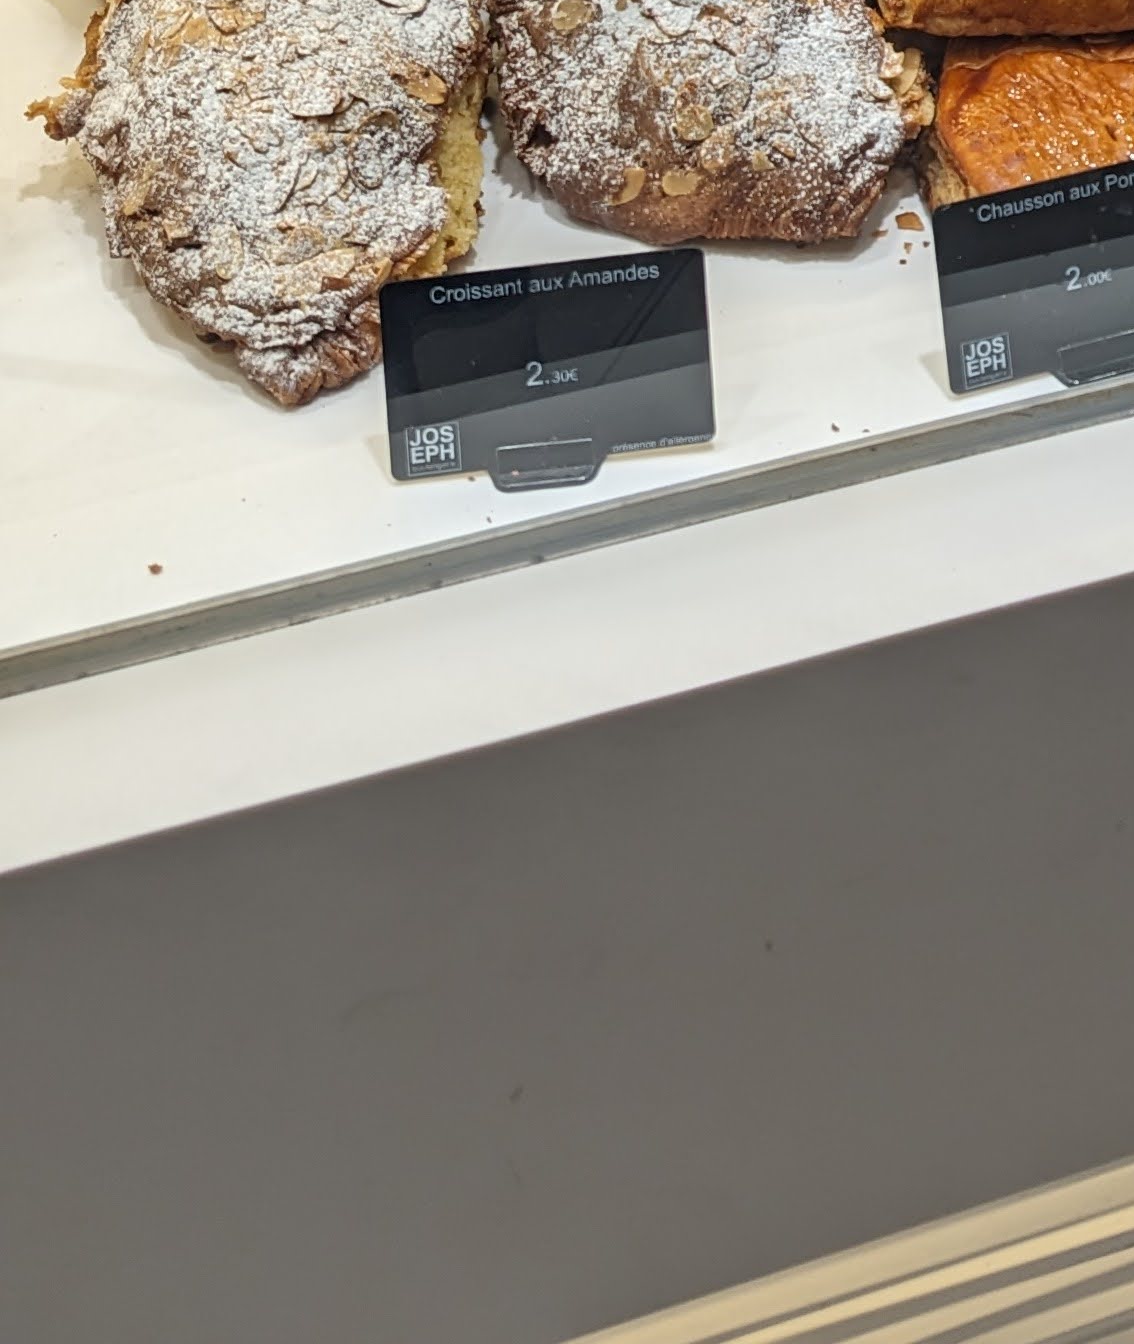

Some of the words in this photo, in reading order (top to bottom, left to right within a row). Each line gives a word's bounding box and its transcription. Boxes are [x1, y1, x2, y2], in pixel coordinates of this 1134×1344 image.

[976, 189, 1065, 223] Chausson
[1069, 181, 1100, 201] aux
[429, 281, 524, 306] Croissant
[528, 276, 564, 295] aux
[568, 262, 660, 289] Amandes
[966, 337, 1005, 361] JOS
[967, 355, 1007, 378] EPH
[409, 426, 455, 448] JOS
[410, 444, 455, 465] EPH
